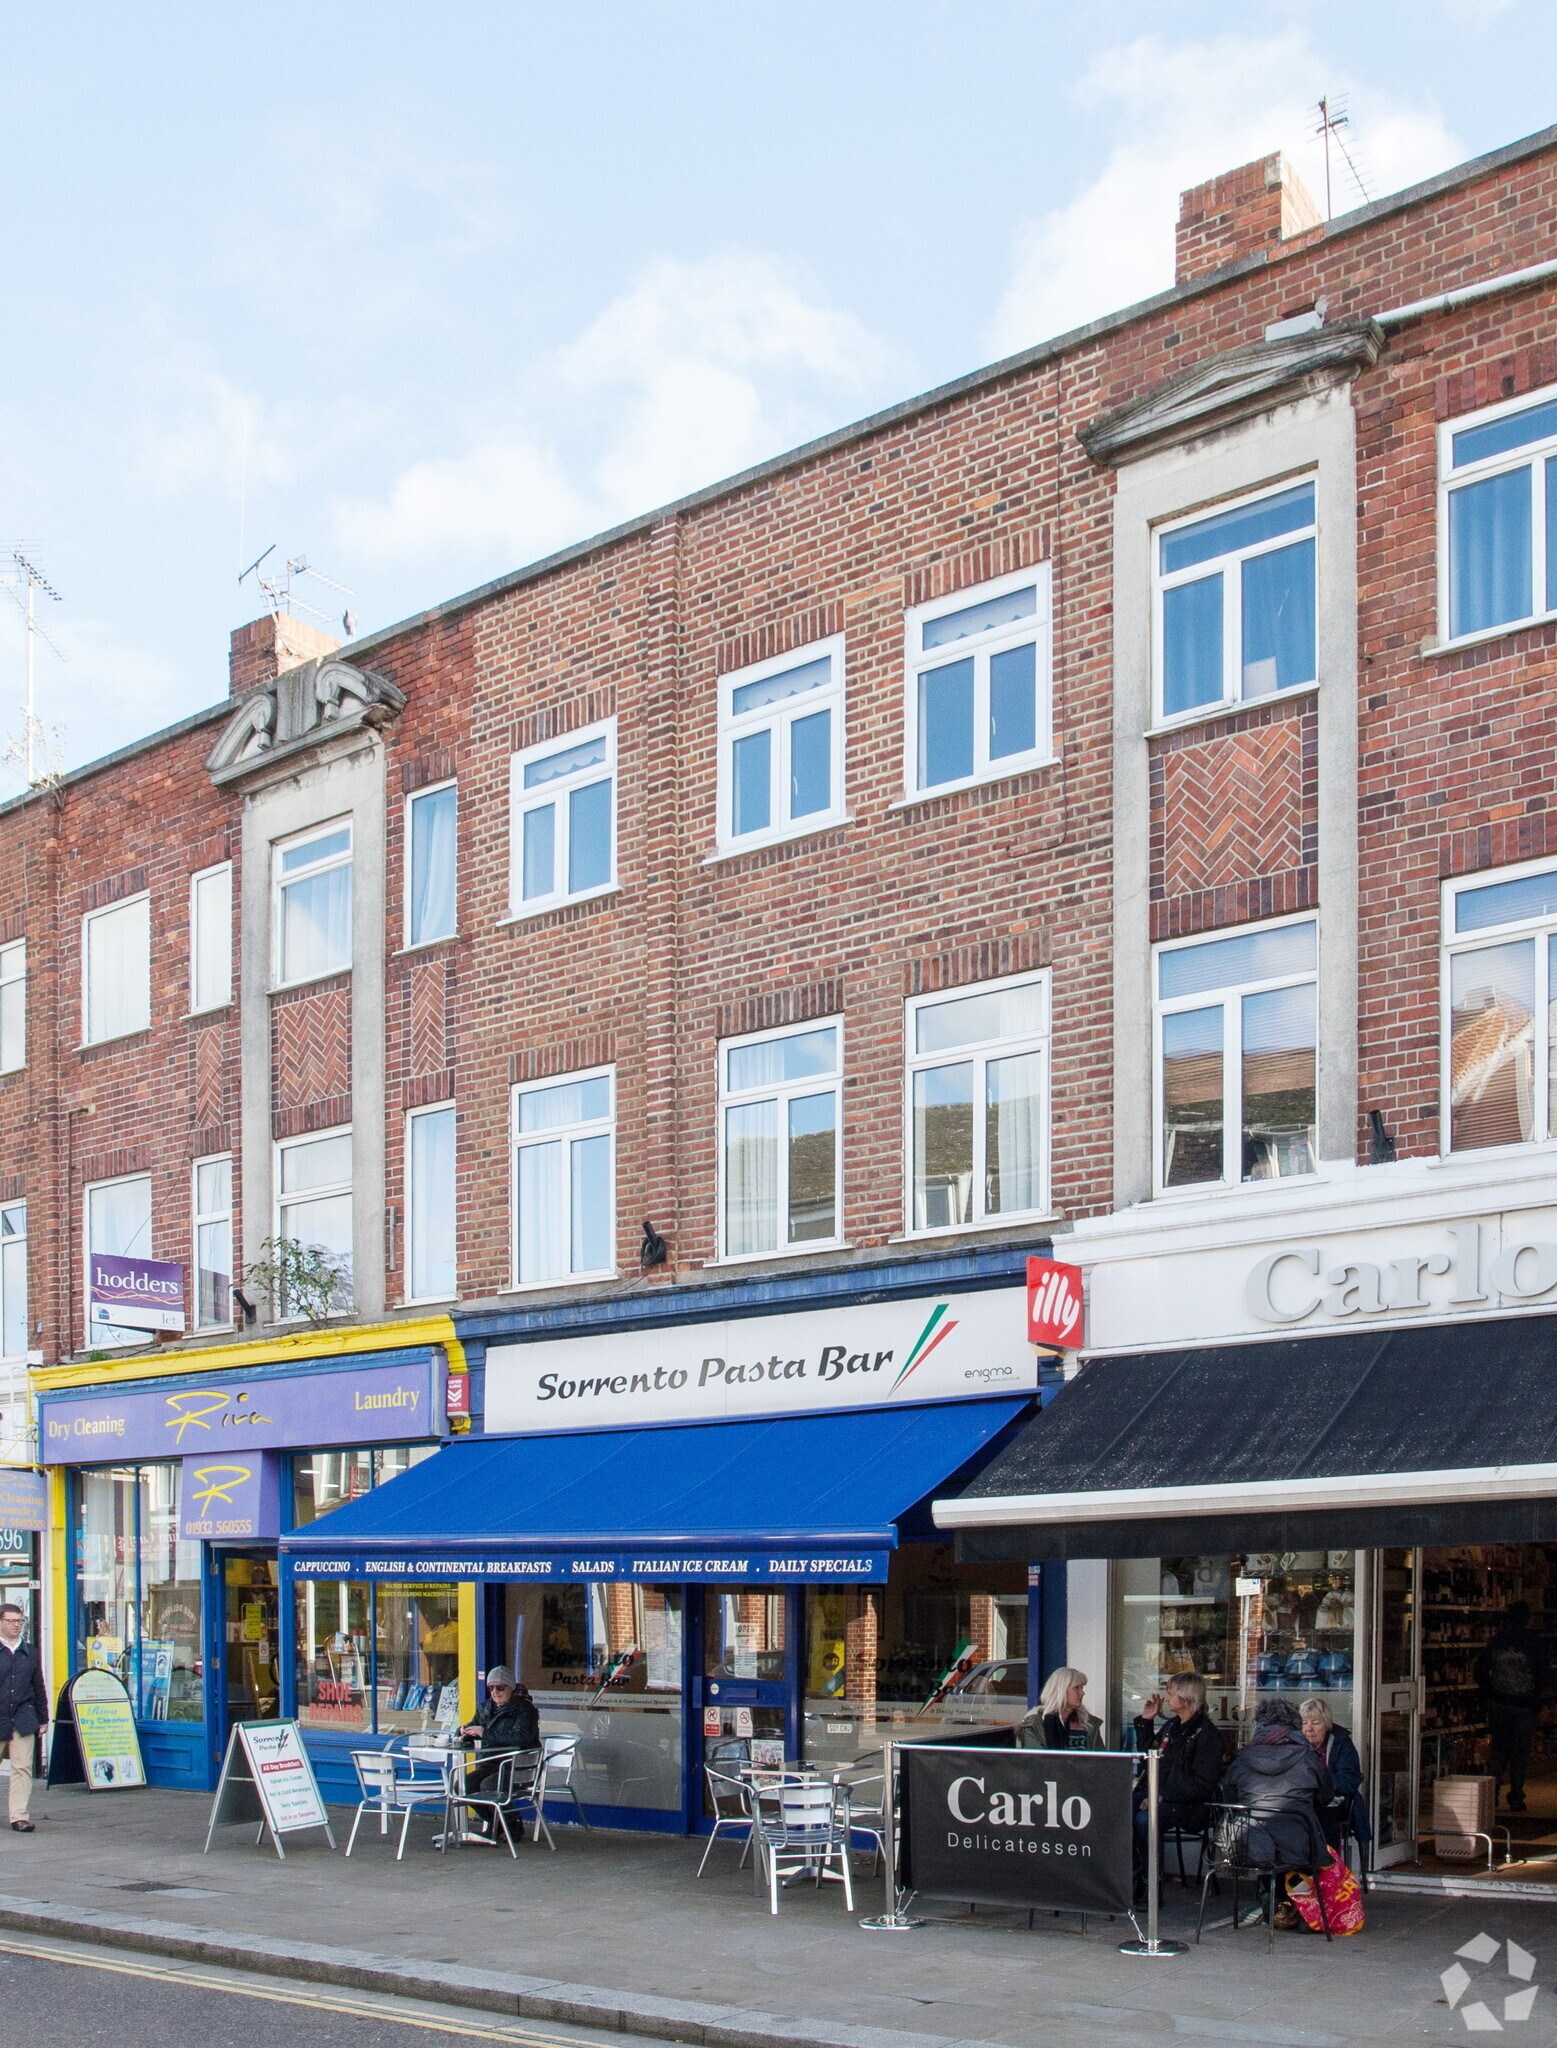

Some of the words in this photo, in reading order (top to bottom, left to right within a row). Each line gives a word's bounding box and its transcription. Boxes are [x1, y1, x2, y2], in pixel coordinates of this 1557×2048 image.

[96, 1267, 179, 1295] hodders
[1244, 1222, 1557, 1323] Carlo
[1032, 1271, 1080, 1338] illy
[162, 1313, 176, 1325] let
[536, 1365, 688, 1401] Sorrento
[698, 1355, 806, 1387] Pasta
[817, 1346, 894, 1381] Bar
[964, 1366, 1013, 1383] enigma
[354, 1386, 420, 1411] Laundry
[49, 1420, 70, 1442] Dry
[74, 1415, 126, 1437] Cleaning
[165, 1391, 273, 1445] Riva
[185, 1520, 213, 1535] 01932
[215, 1519, 252, 1534] 560555
[294, 1561, 351, 1573] CAPPUCCINO
[365, 1561, 406, 1573] ENGLISH
[407, 1561, 415, 1573] &
[415, 1561, 485, 1573] CONTINENTAL
[486, 1561, 552, 1573] BREAKFASTS
[571, 1561, 615, 1573] SALADS
[632, 1560, 681, 1572] ITALIAN
[682, 1560, 703, 1572] ICE
[704, 1560, 748, 1572] CREAM
[769, 1560, 808, 1572] DAILY
[809, 1559, 873, 1572] SPECIALS
[551, 1671, 596, 1686] Pasta
[318, 1682, 352, 1702] SHOE
[308, 1702, 364, 1723] REPAIRS
[270, 1763, 280, 1771] Day
[947, 1776, 1092, 1830] Carlo
[947, 1832, 1091, 1857] Delicatessen
